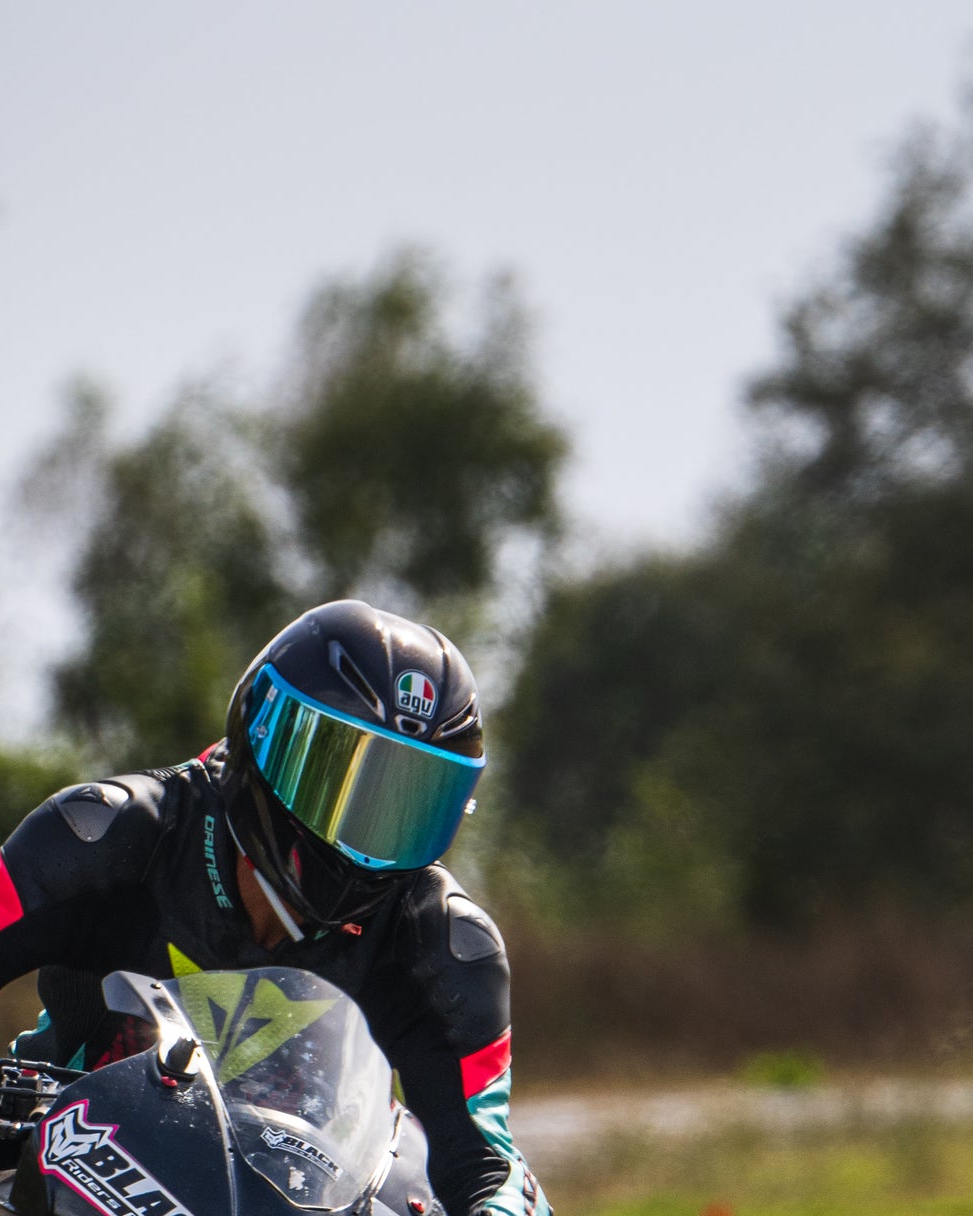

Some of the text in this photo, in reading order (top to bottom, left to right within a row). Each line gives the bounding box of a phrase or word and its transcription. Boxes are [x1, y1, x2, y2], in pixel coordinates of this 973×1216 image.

[204, 814, 234, 908] DAINESE
[284, 1137, 339, 1173] BLACK
[62, 1158, 121, 1210] Riders
